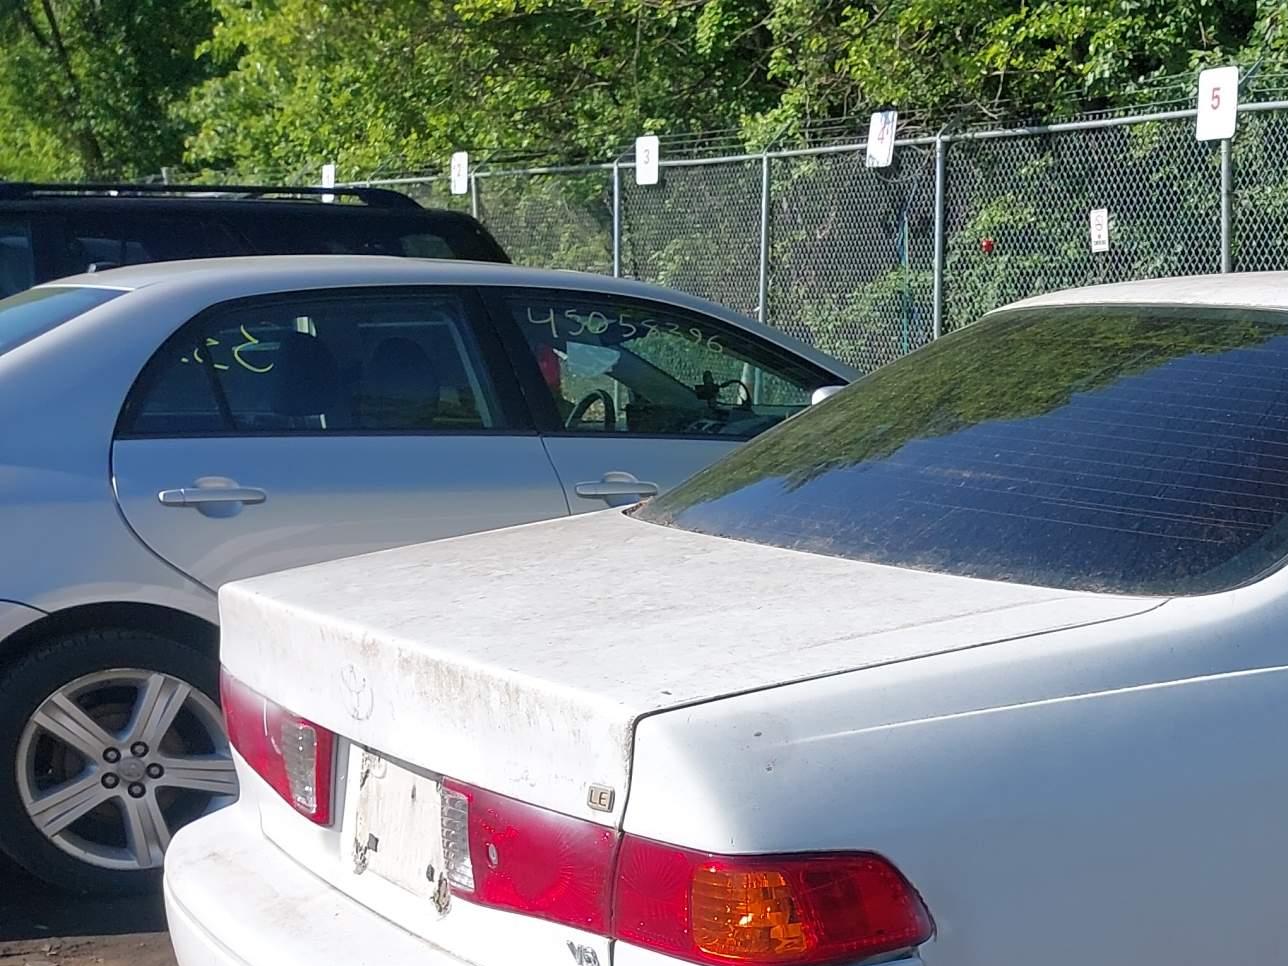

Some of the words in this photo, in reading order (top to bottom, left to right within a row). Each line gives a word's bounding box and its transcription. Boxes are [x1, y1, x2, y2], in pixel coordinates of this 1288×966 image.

[1211, 87, 1221, 110] 5
[643, 149, 650, 165] 3
[527, 307, 723, 353] 45058296
[589, 789, 609, 807] LE
